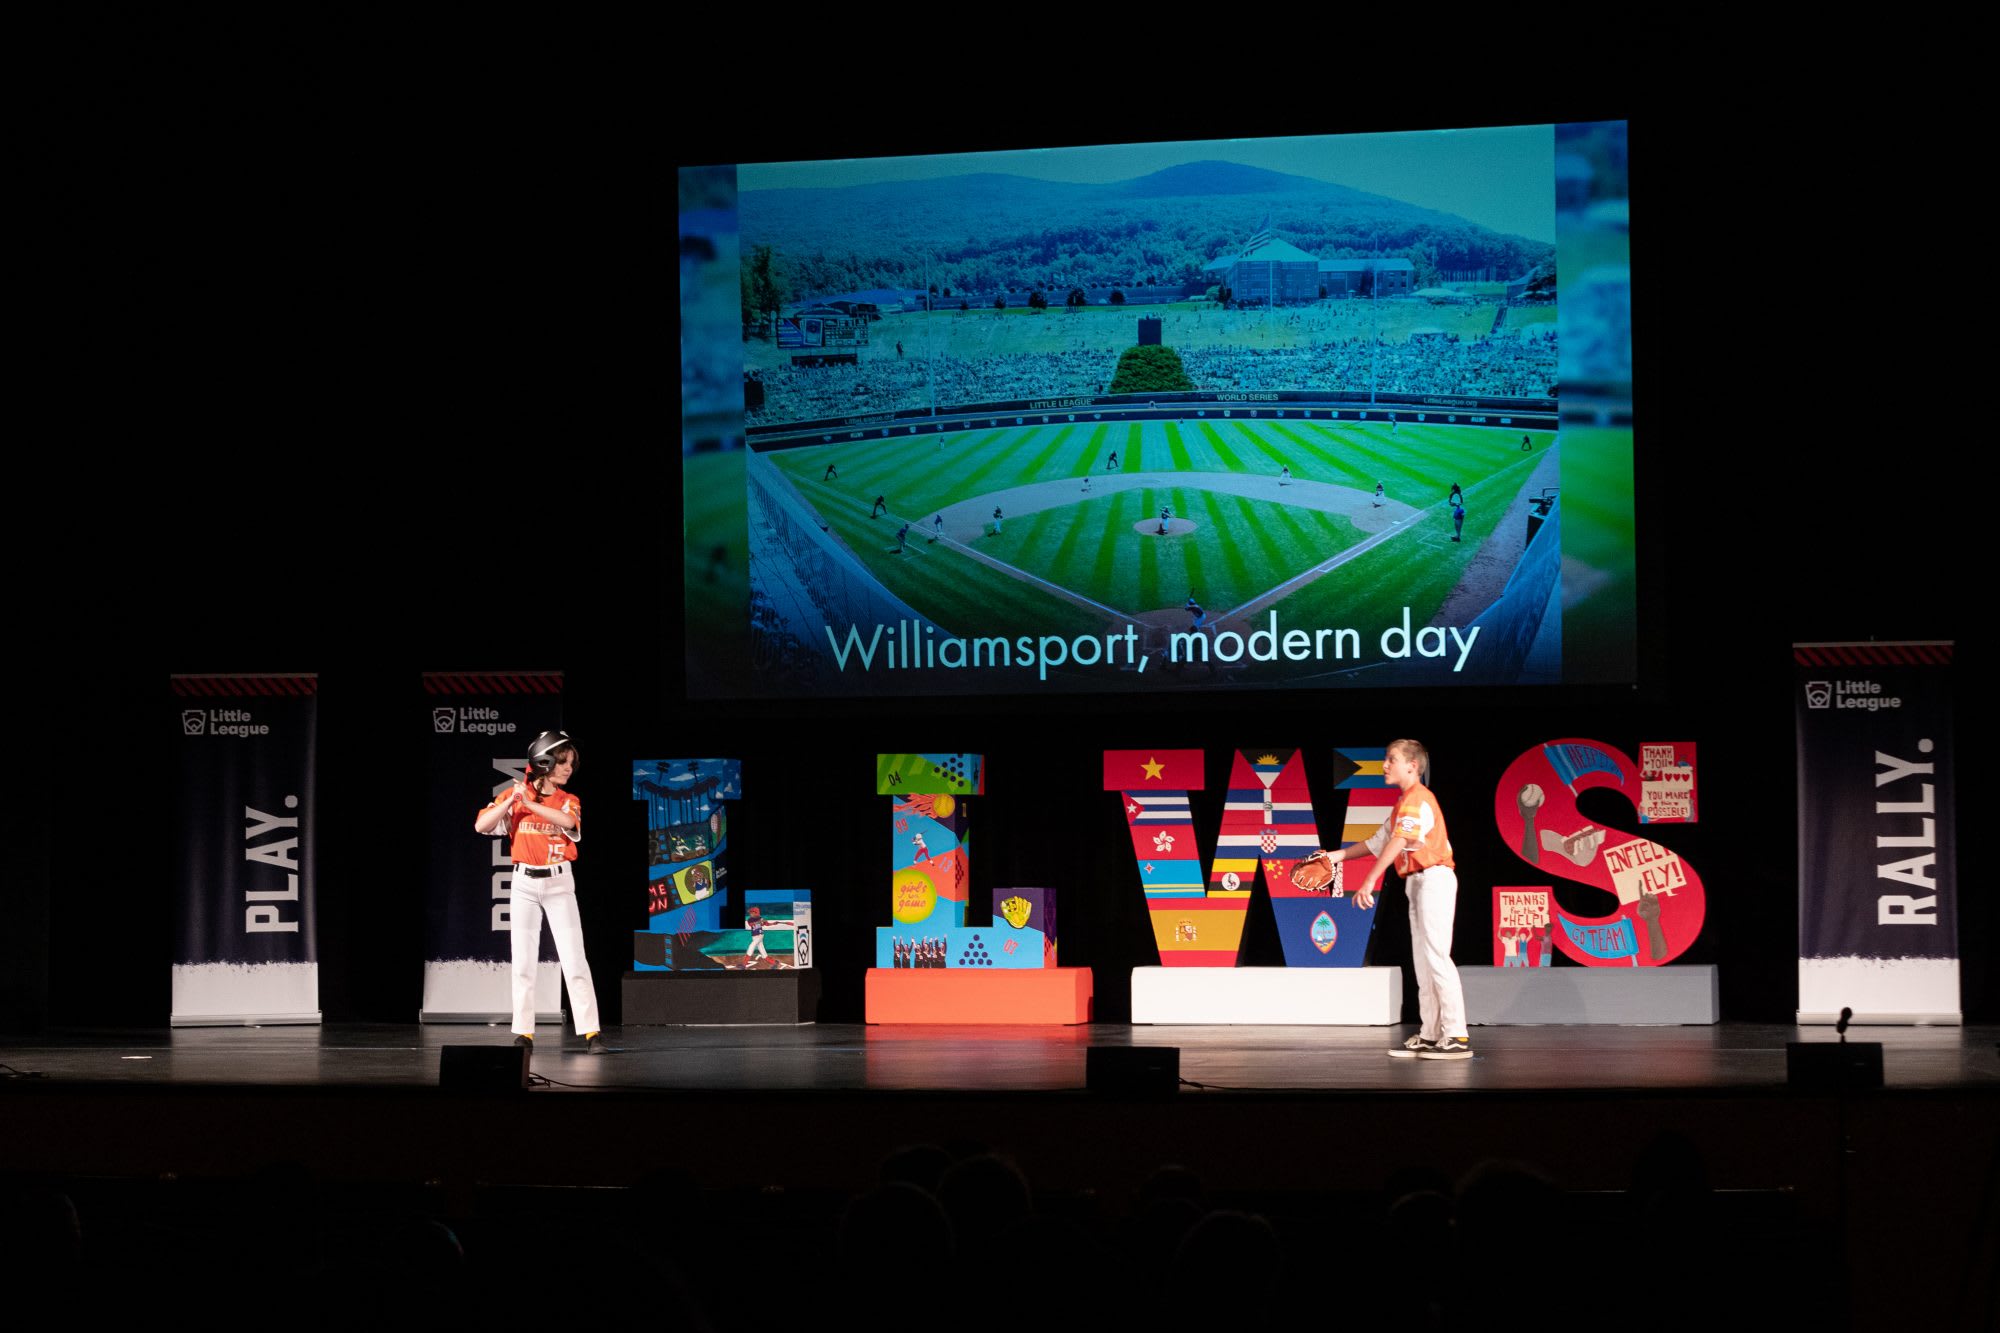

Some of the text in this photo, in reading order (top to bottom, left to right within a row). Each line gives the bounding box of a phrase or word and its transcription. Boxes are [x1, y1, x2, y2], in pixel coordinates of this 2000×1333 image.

[1029, 398, 1092, 409] LITTLE LEAGUE
[1216, 393, 1279, 401] WORLD SERIES
[826, 606, 1480, 680] Williamsport, modern day
[1836, 680, 1881, 694] Little
[1836, 695, 1901, 712] League
[210, 709, 251, 722] Little
[460, 707, 499, 720] Little
[210, 722, 270, 738] League
[460, 721, 517, 736] League
[1651, 759, 1668, 768] YOU
[888, 770, 902, 786] 04
[1647, 790, 1689, 800] YOU MAKE
[1875, 738, 1937, 926] RALLY.
[547, 843, 566, 865] 15
[245, 795, 299, 933] PLAY.
[1641, 861, 1683, 892] FLY!
[1502, 895, 1545, 906] THANKS
[1571, 927, 1626, 951] GO TEAM
